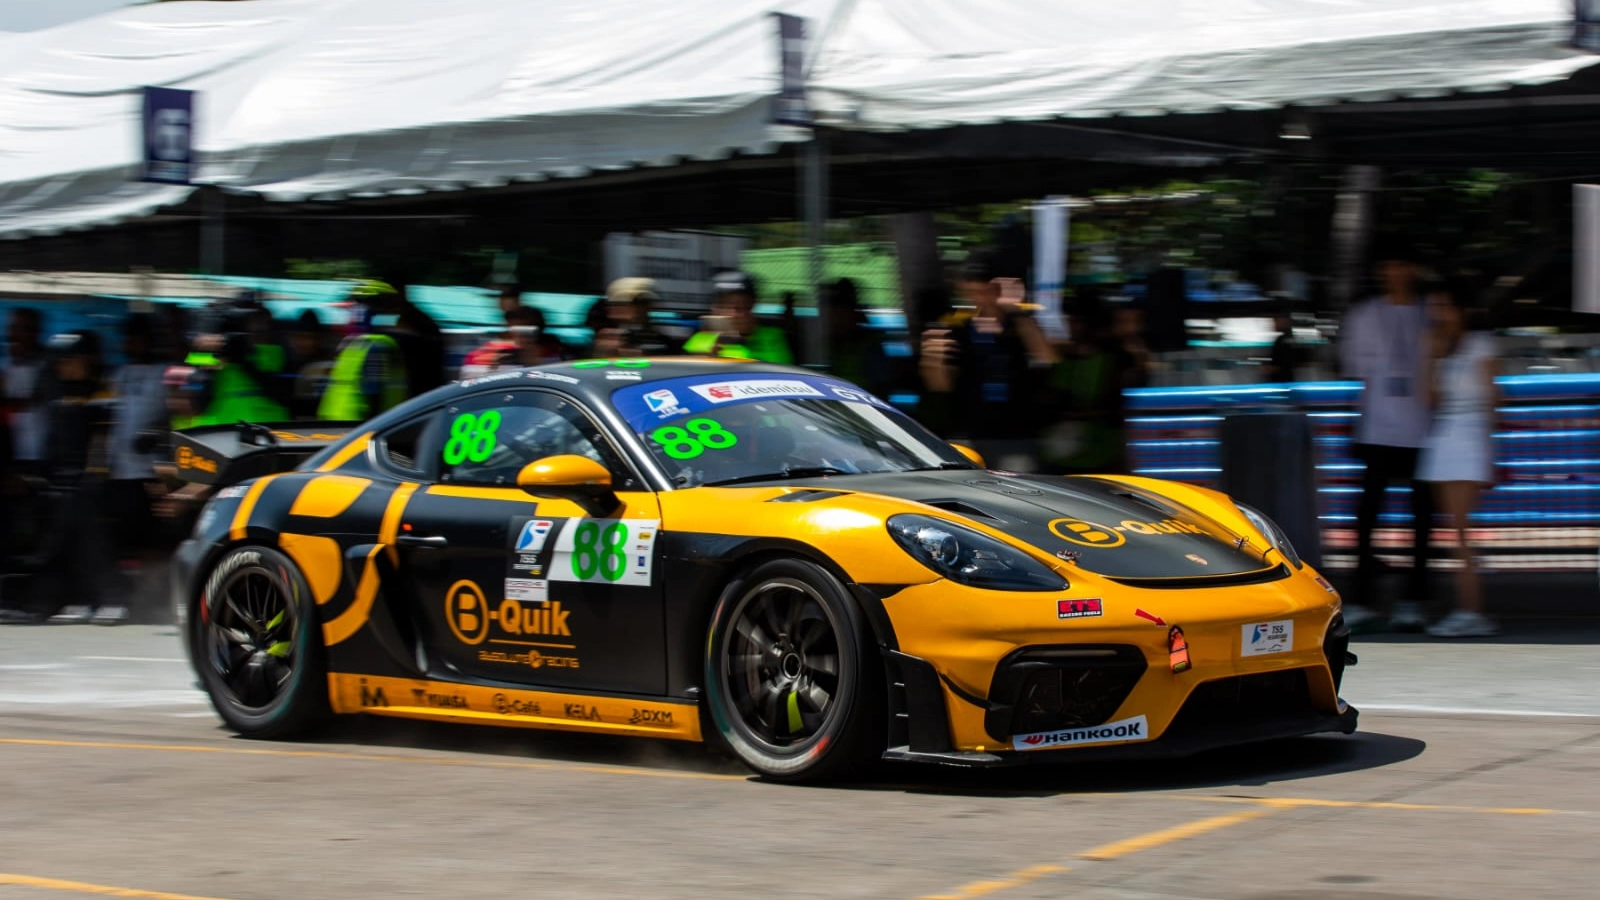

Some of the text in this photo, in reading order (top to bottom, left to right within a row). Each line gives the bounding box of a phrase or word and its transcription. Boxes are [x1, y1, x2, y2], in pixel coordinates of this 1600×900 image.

[738, 384, 814, 396] idemitsu
[443, 410, 502, 465] 88
[652, 418, 737, 459] 88
[571, 521, 628, 581] 88
[445, 579, 571, 645] B-Quik
